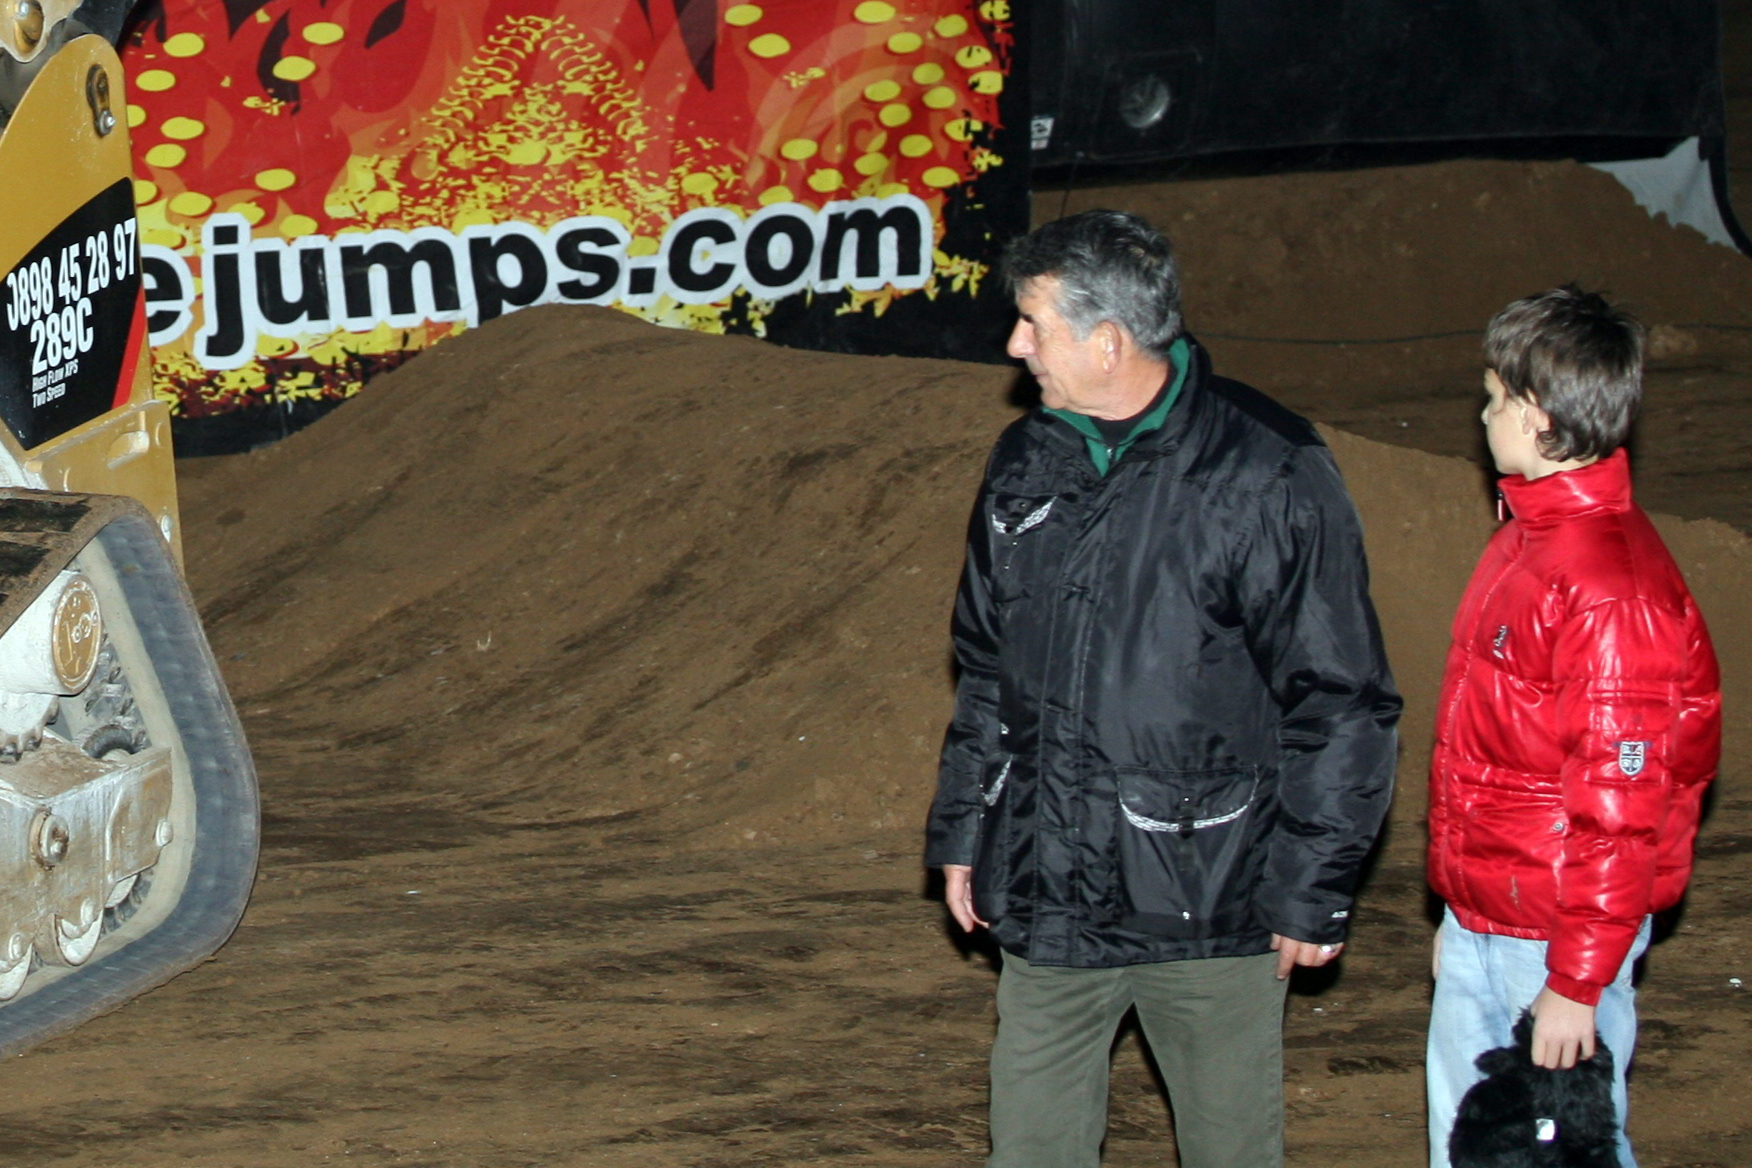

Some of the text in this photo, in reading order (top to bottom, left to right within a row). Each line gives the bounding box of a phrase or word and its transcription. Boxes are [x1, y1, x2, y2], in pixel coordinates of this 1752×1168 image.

[58, 243, 82, 305] 45
[86, 230, 110, 295] 28
[113, 217, 136, 281] 97
[29, 297, 95, 375] 289C
